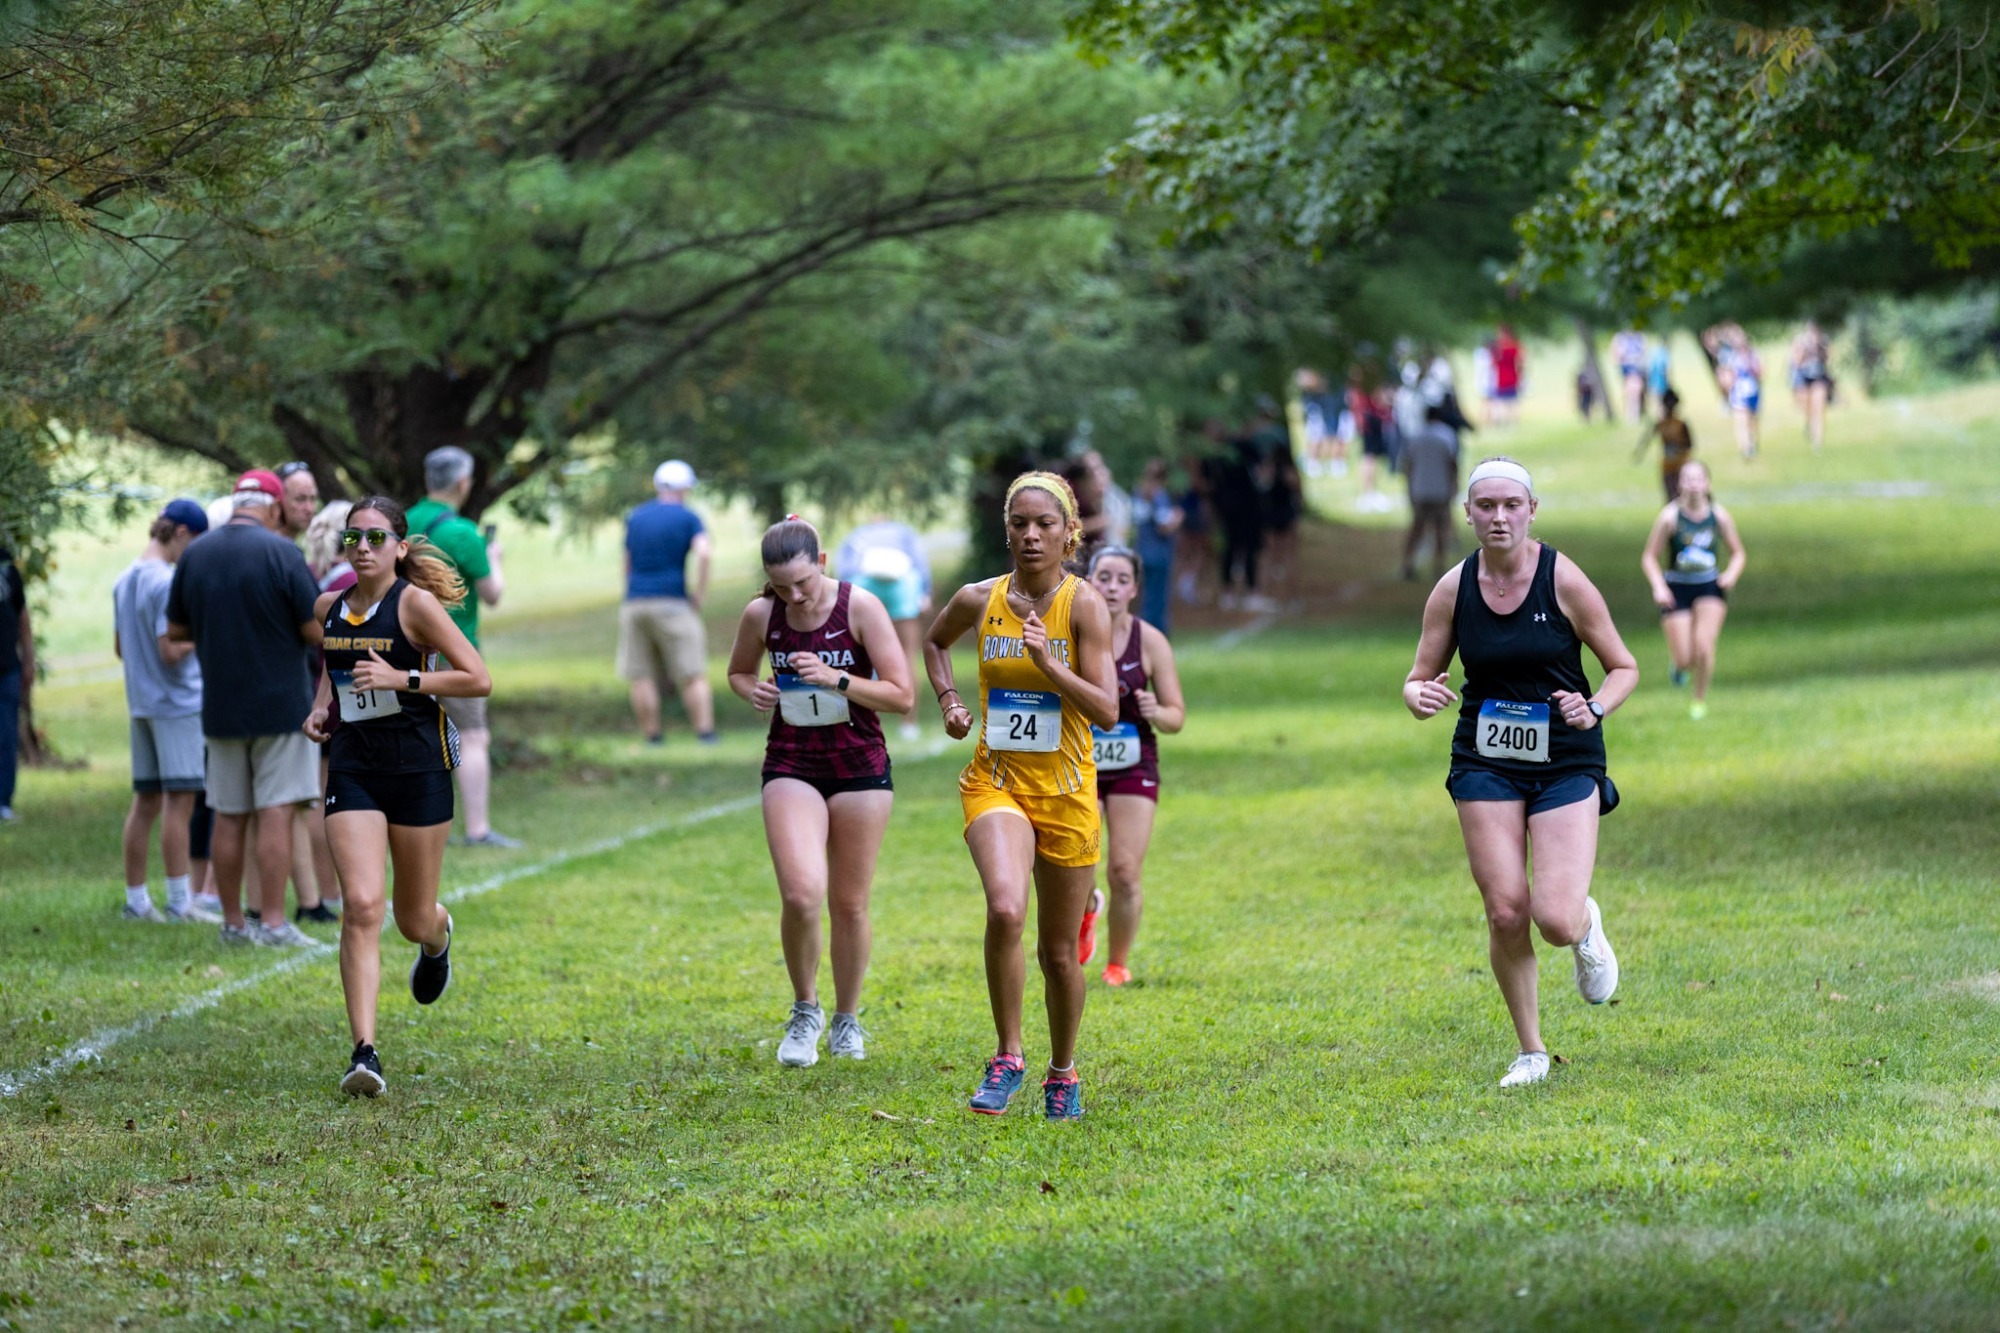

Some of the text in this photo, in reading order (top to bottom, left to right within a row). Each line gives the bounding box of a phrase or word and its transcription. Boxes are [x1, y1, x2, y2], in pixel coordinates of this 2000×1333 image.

[353, 637, 394, 651] CREST
[983, 636, 1024, 662] BOWIE
[769, 649, 855, 668] ARCDIA
[356, 688, 377, 710] 51
[809, 693, 819, 717] 1
[1004, 692, 1044, 700] FALCON
[1495, 702, 1533, 711] FALCON
[1009, 713, 1037, 740] 24
[1486, 723, 1538, 752] 2400
[1093, 742, 1126, 762] 342
